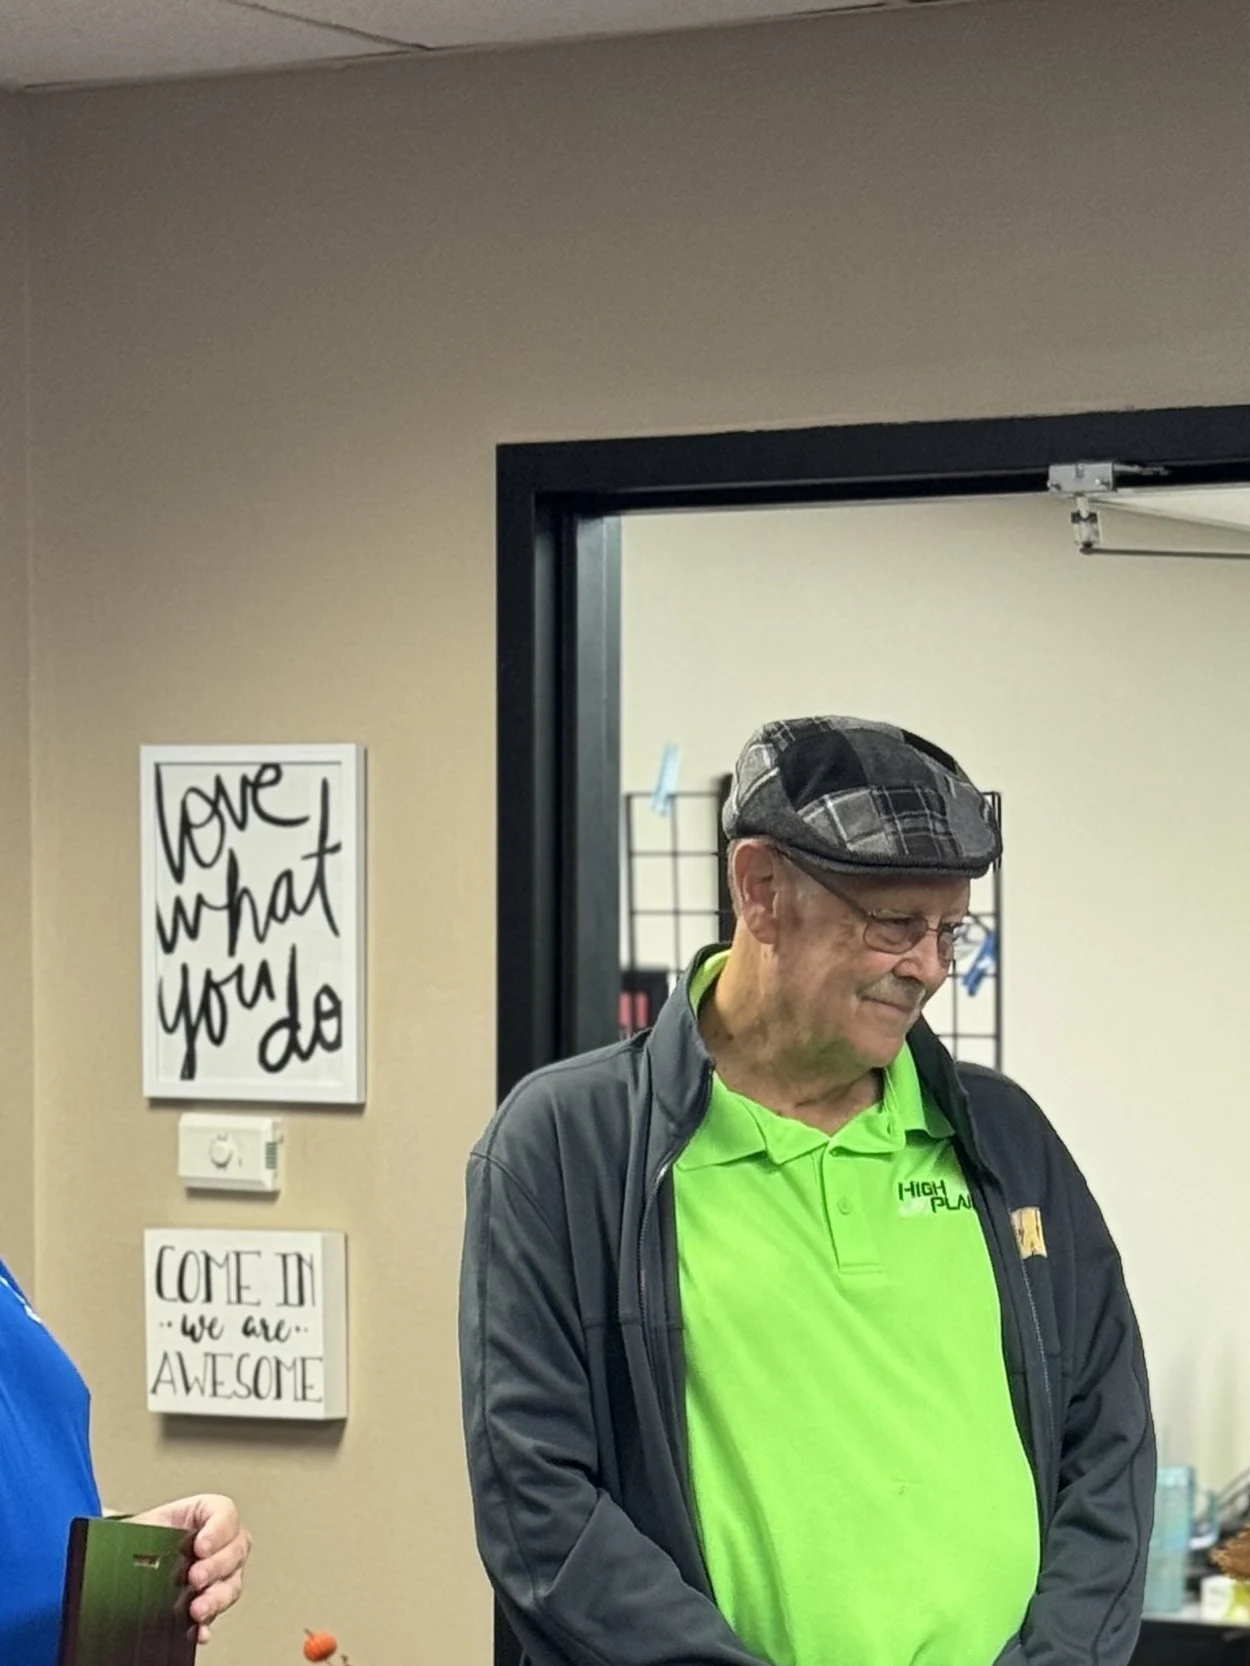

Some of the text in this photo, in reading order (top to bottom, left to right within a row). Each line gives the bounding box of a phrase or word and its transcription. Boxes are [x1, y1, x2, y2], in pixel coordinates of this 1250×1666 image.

[156, 777, 342, 958] what
[158, 943, 343, 1081] you do
[898, 1179, 947, 1201] HIGH
[155, 1245, 316, 1308] COME IN
[180, 1313, 292, 1344] we are
[150, 1350, 324, 1403] AWESOME
